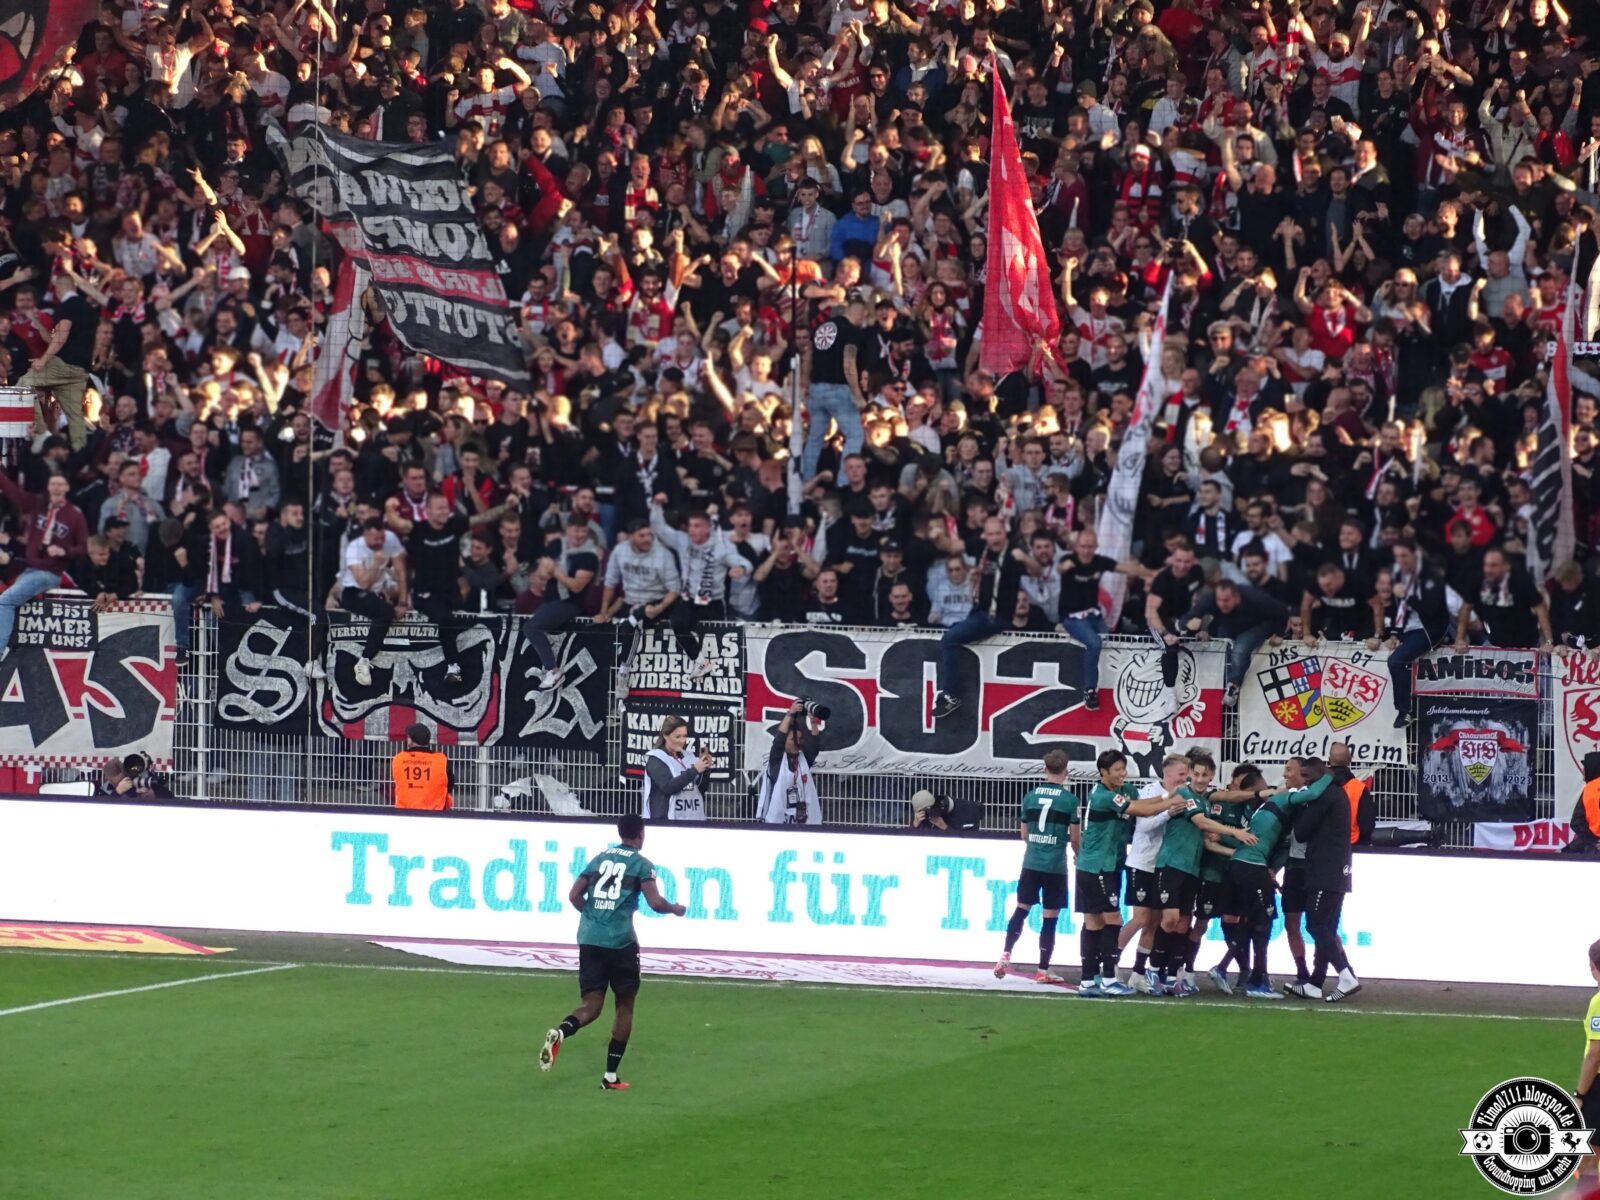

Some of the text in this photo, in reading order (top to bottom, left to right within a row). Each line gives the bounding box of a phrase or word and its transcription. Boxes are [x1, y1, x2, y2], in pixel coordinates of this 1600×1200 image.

[18, 616, 91, 635] IMMER
[18, 632, 94, 649] BEI UNS!
[1269, 646, 1373, 667] DKS 07
[694, 716, 730, 734] UND
[699, 733, 729, 754] FÜR
[1243, 731, 1402, 763] Gundelheim
[404, 766, 431, 781] 191
[1424, 774, 1449, 784] 2013
[1507, 776, 1532, 786] 2023
[675, 799, 700, 811] SMF
[1038, 797, 1053, 833] 7
[593, 859, 627, 900] 23
[767, 850, 899, 926] für
